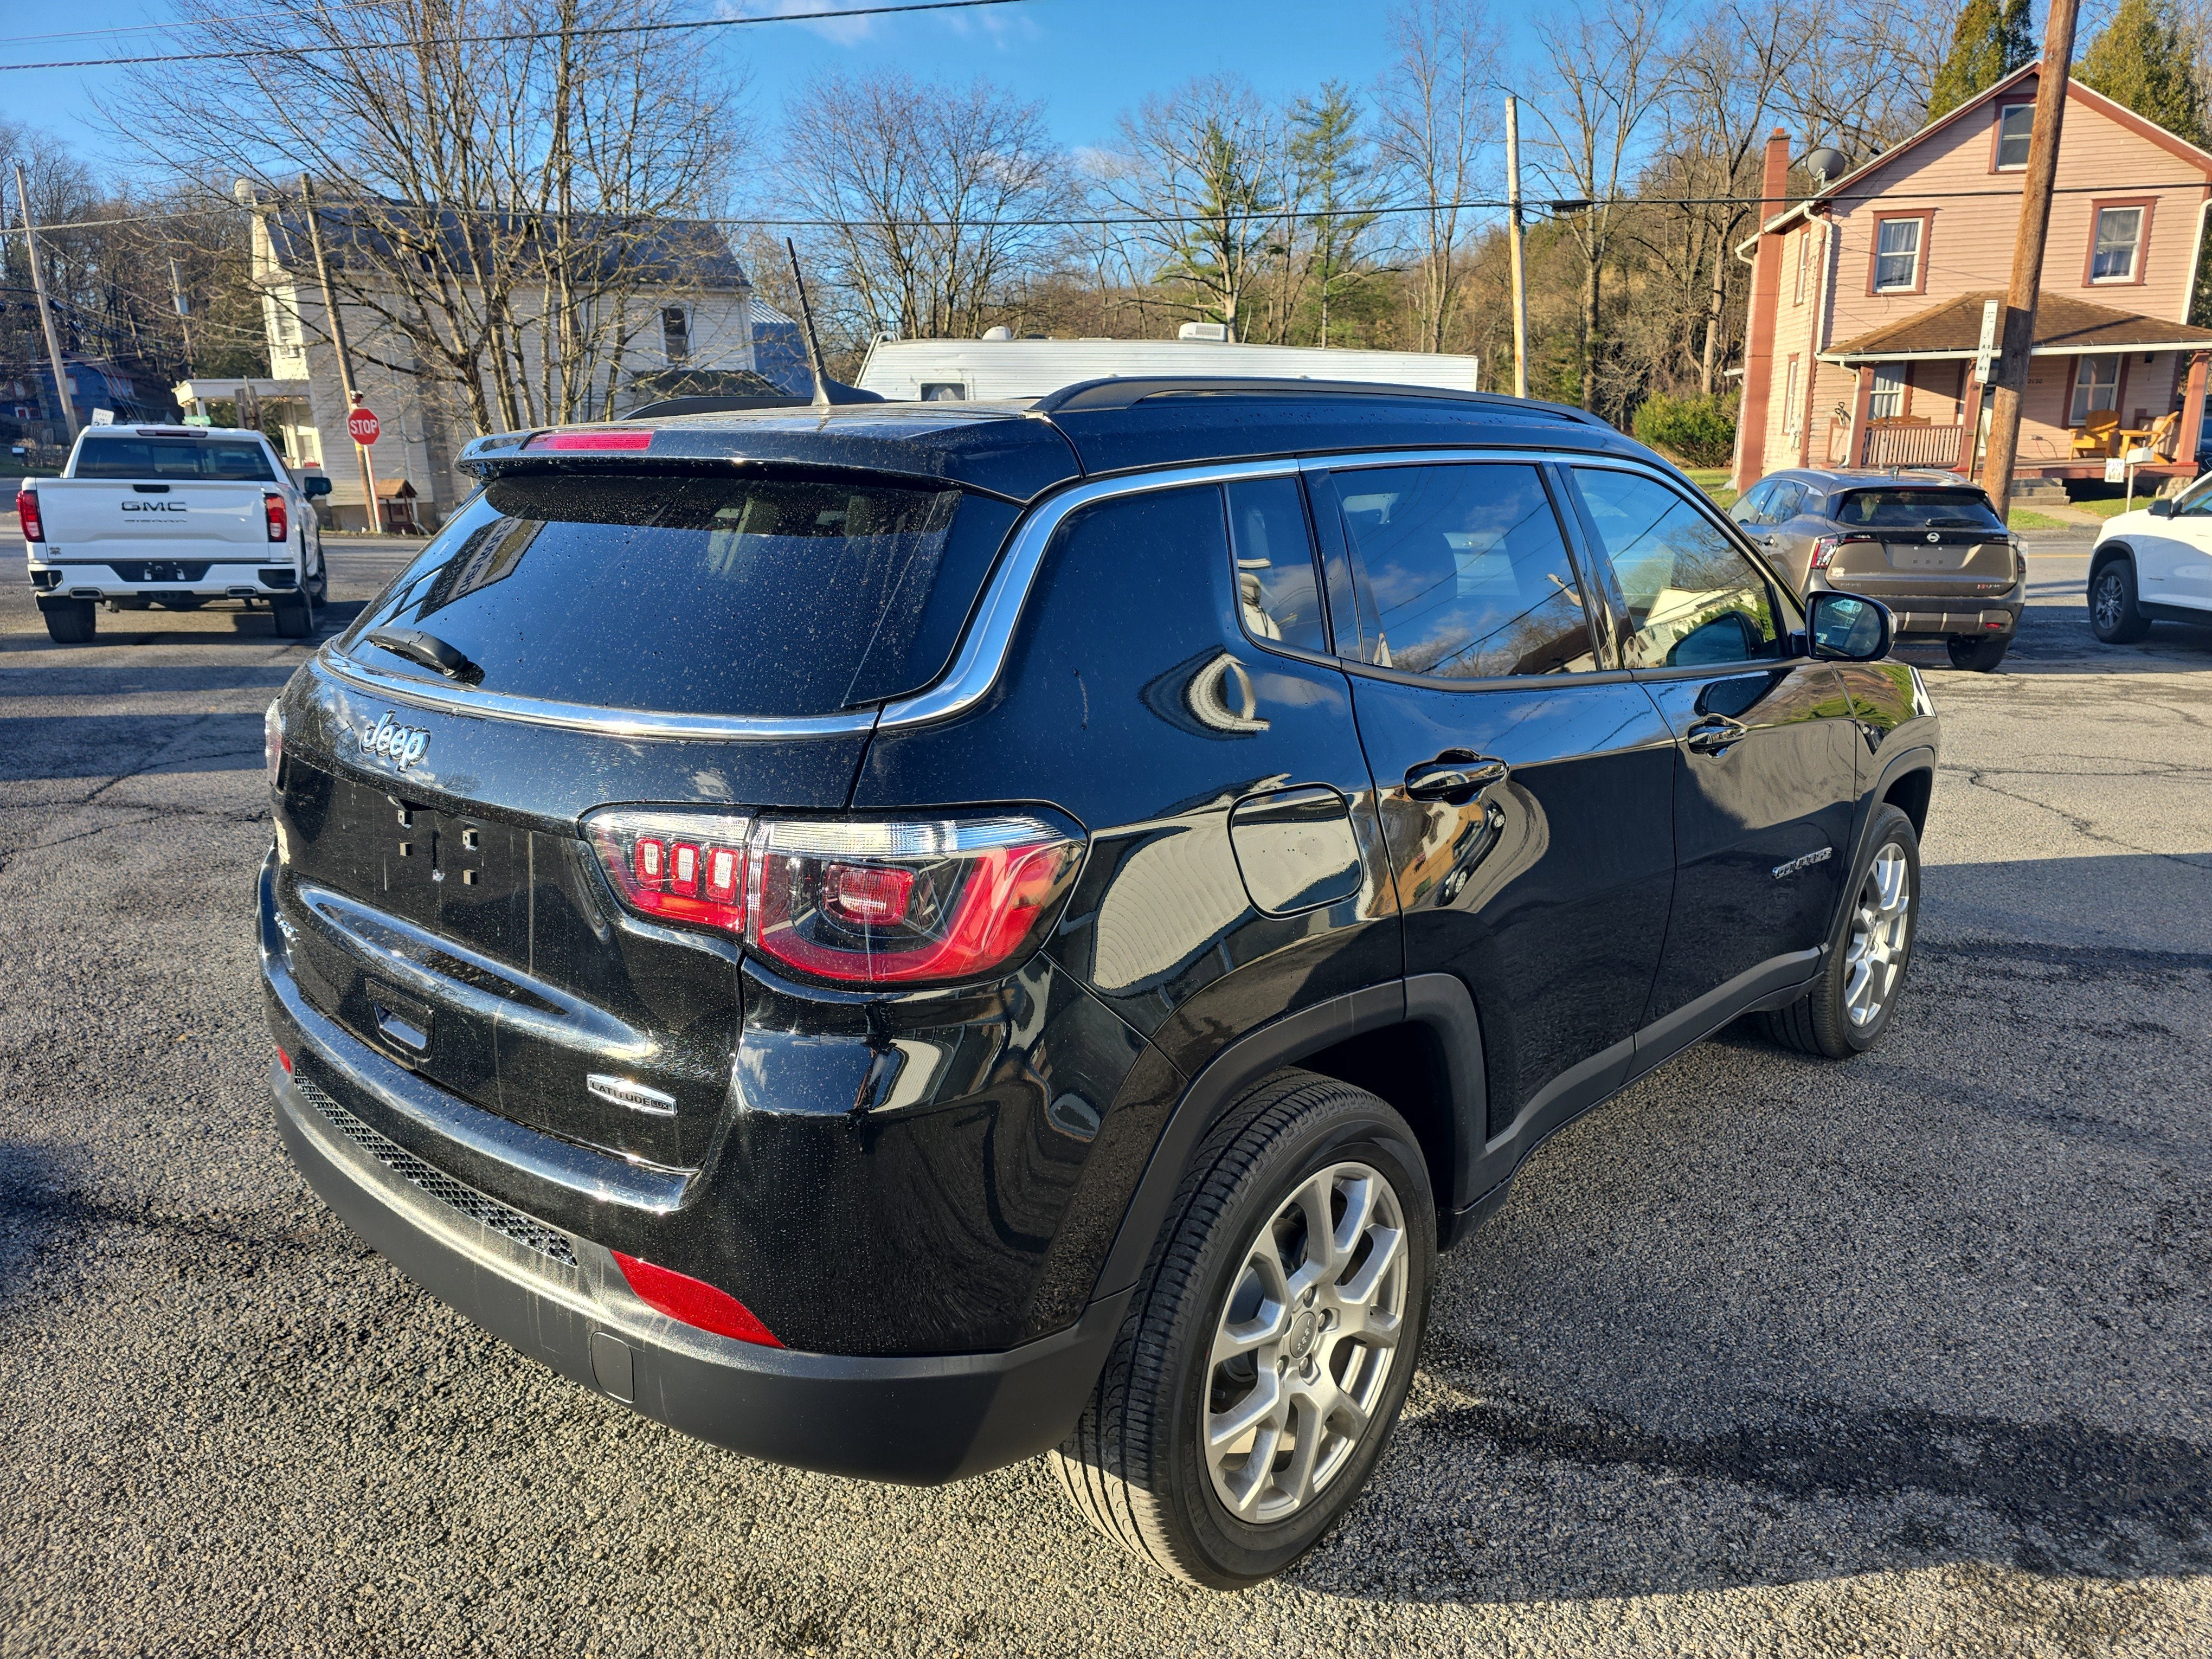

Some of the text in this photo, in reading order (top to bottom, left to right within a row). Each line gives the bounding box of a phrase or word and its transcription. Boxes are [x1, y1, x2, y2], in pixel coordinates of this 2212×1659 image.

[350, 419, 377, 435] STOP
[121, 501, 187, 511] GMC
[360, 709, 431, 773] Jeep
[589, 1079, 669, 1110] LATITUDE LUX
